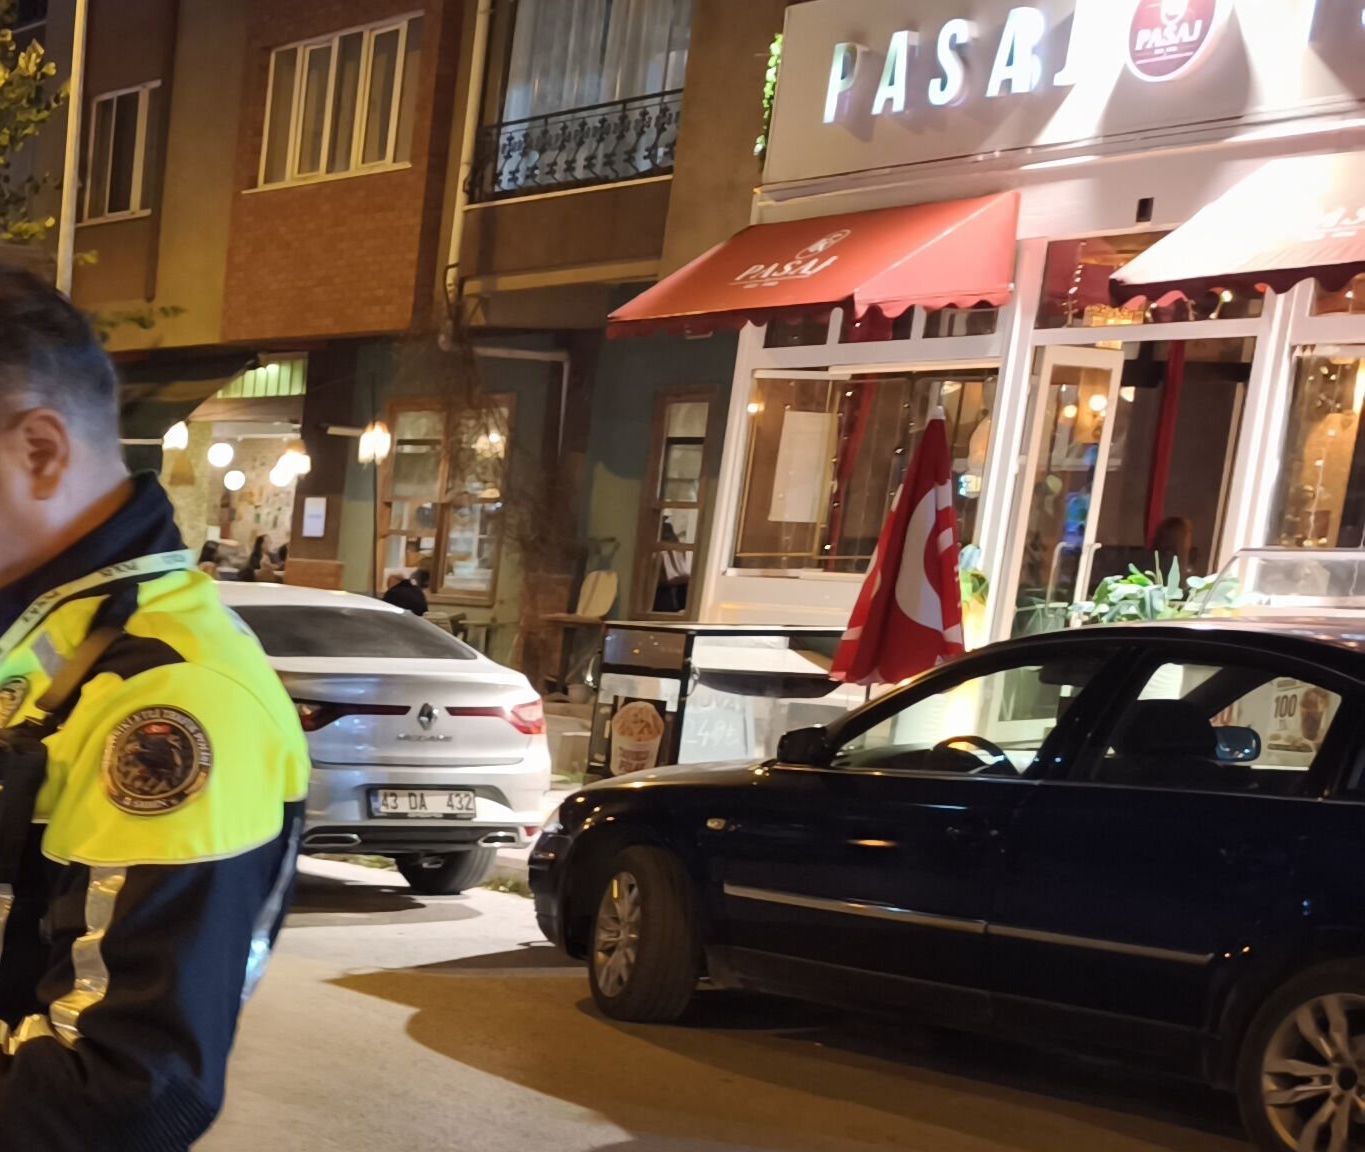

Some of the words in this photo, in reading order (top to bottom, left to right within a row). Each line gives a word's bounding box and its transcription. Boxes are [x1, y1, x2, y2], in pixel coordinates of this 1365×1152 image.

[1273, 693, 1298, 719] 100
[380, 791, 399, 810] 43
[407, 792, 428, 811] DA
[446, 792, 474, 811] 432
